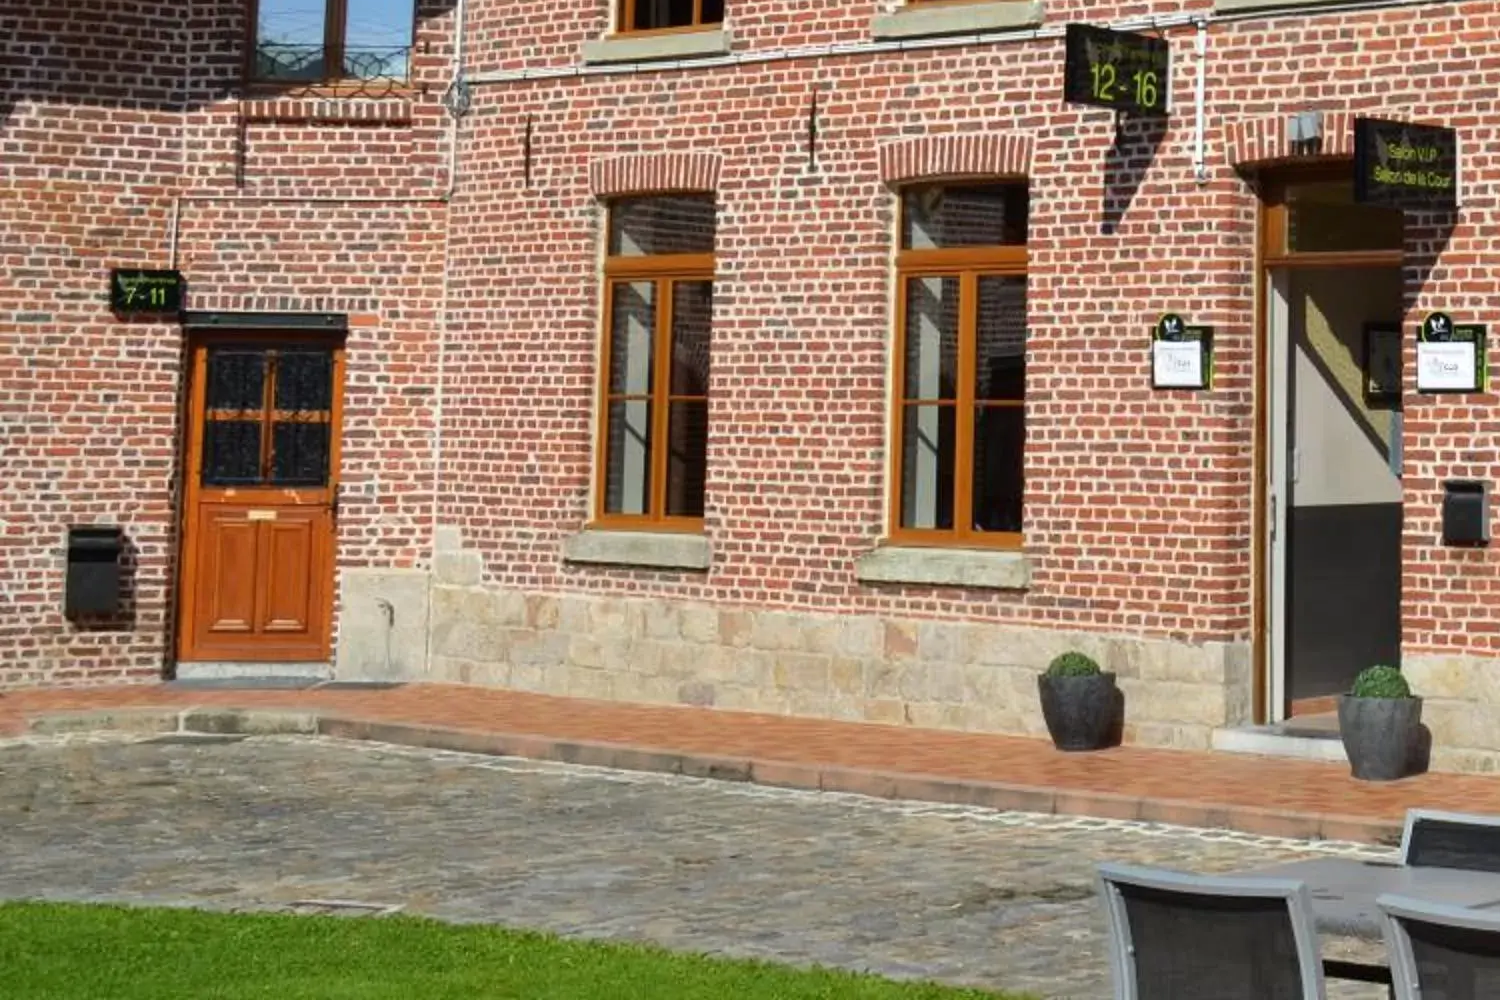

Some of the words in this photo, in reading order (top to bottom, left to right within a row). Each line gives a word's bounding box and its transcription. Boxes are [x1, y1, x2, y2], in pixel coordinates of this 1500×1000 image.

[1091, 62, 1116, 100] 12
[1133, 70, 1157, 107] 16
[1403, 170, 1416, 185] de
[1427, 171, 1452, 188] Cour
[126, 287, 137, 304] 7
[150, 287, 165, 305] 11
